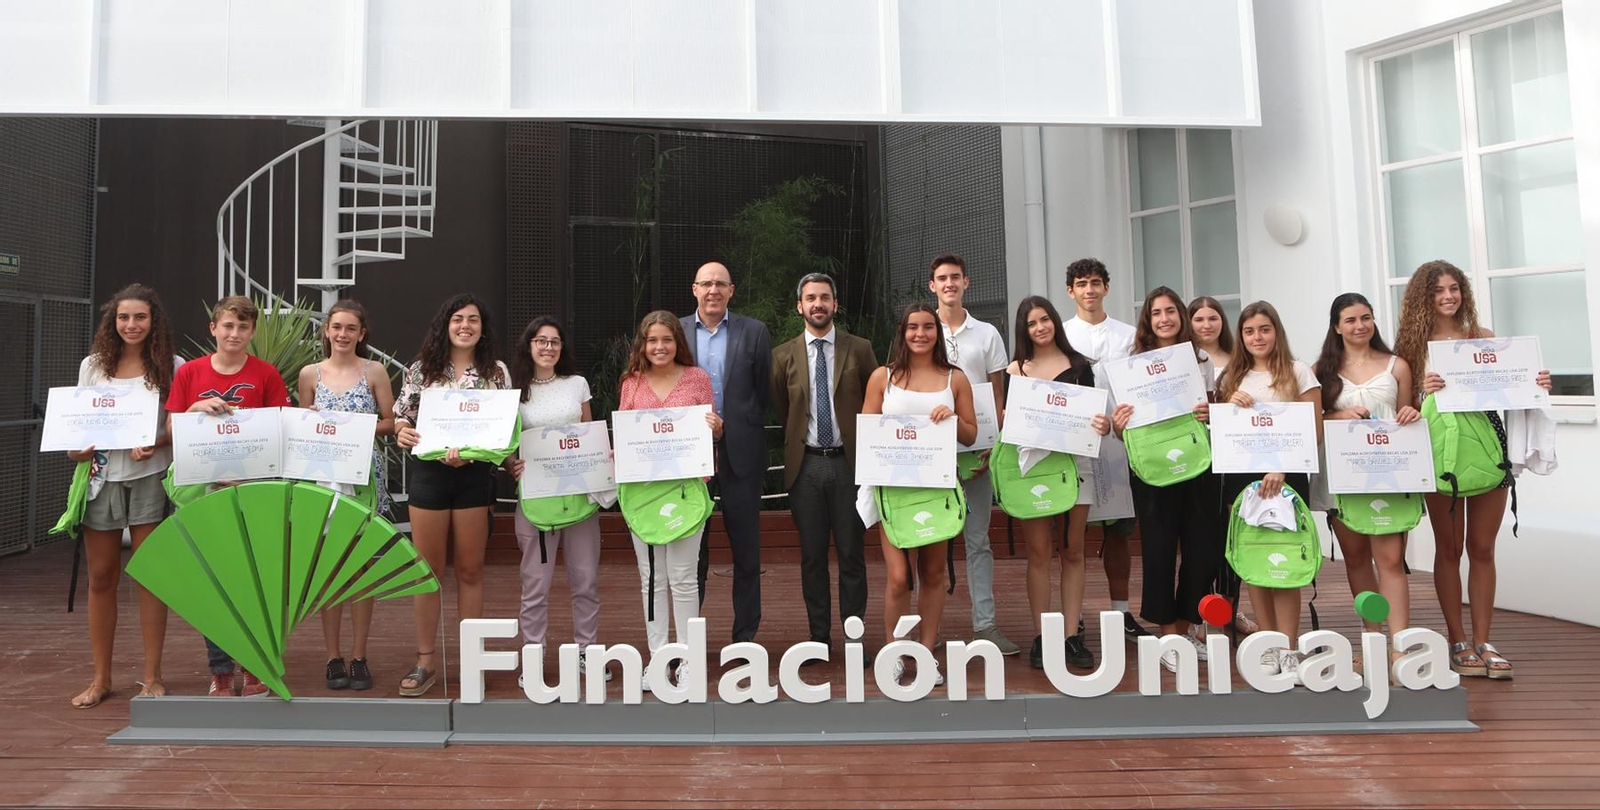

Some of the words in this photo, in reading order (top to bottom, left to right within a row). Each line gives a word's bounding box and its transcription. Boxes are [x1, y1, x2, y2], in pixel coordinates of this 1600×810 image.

[1473, 353, 1497, 364] Usa
[1146, 363, 1167, 376] Usa
[92, 398, 115, 407] Usa
[1047, 394, 1067, 407] Usa
[459, 402, 479, 412] Usa
[1251, 416, 1273, 427] Usa
[217, 424, 240, 434] Usa
[316, 423, 336, 435] Usa
[653, 422, 674, 433] Usa
[896, 428, 916, 440] Usa
[1367, 434, 1389, 445] Usa
[559, 438, 579, 450] Usa
[460, 615, 1006, 704] Fundación
[1040, 591, 1460, 719] Unicaja
